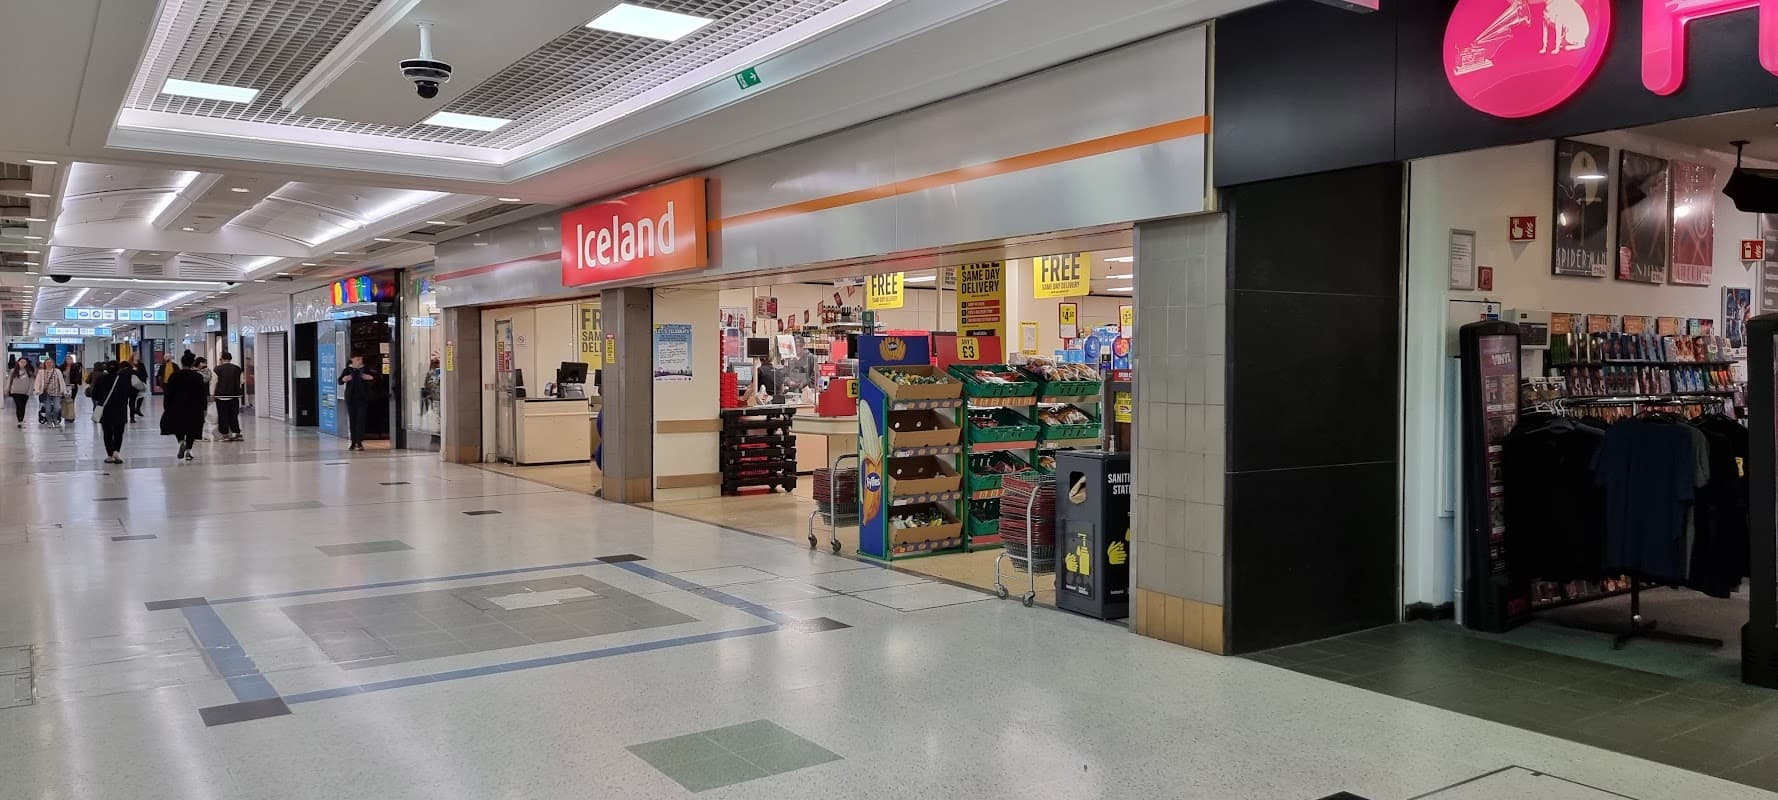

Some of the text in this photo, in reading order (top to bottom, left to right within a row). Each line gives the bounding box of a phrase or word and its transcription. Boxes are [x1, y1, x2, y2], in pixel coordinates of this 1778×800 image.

[577, 201, 675, 269] Iceland
[962, 270, 983, 281] SAME
[984, 268, 1000, 280] DAY
[1041, 253, 1081, 282] FREE
[872, 272, 898, 296] FREE
[962, 280, 999, 294] DELIVERY
[962, 346, 975, 358] £3
